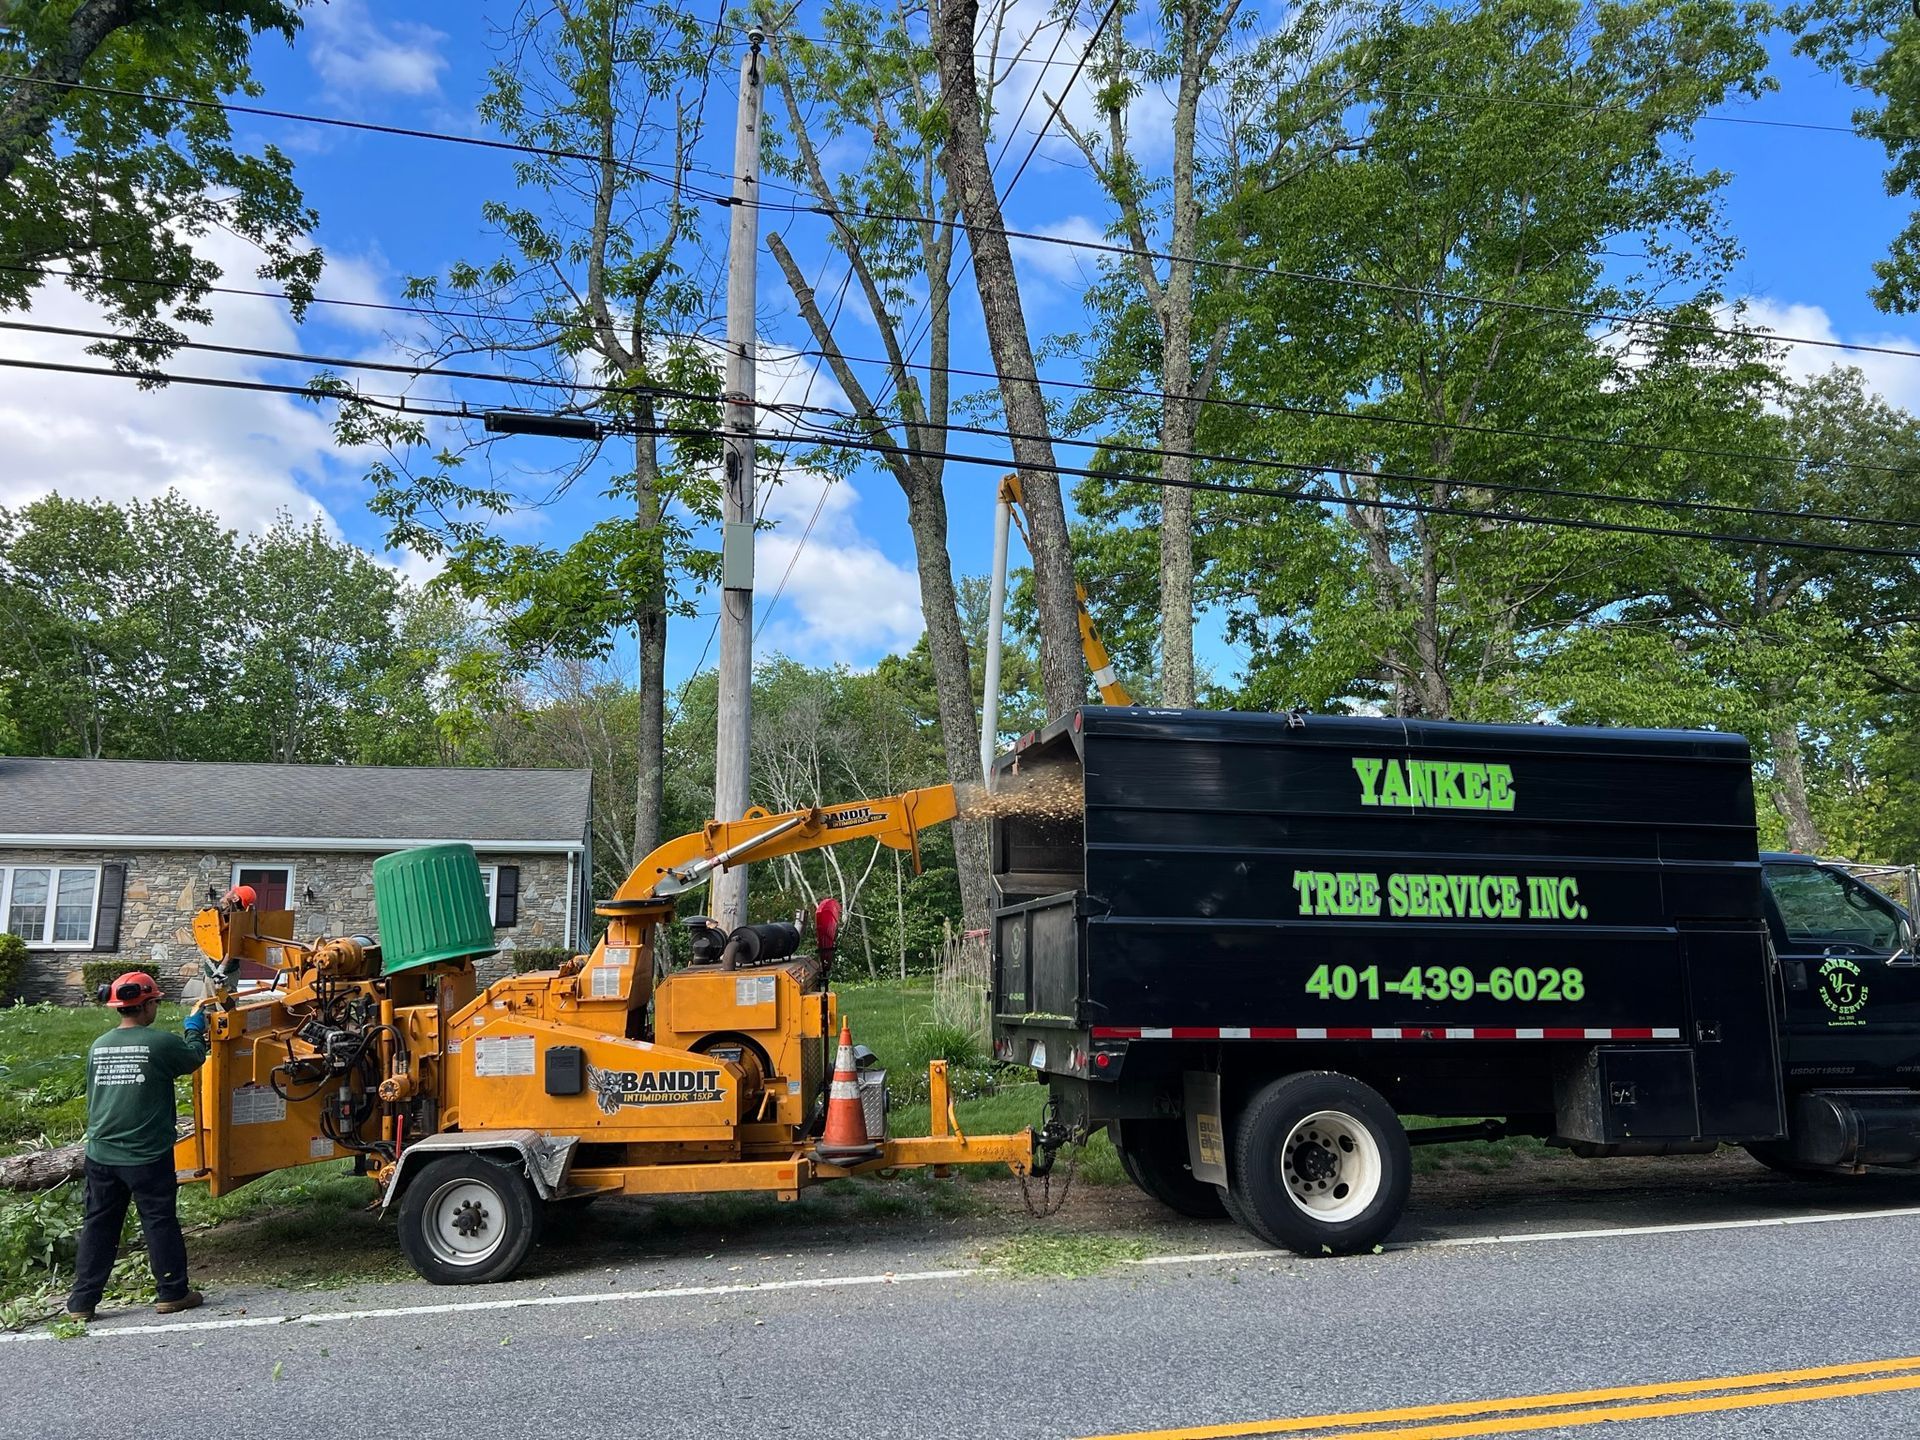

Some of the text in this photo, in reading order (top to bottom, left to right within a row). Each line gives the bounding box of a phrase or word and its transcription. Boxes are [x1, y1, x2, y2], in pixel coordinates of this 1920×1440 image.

[1352, 757, 1516, 811] YANKEE
[1293, 870, 1588, 920] TREE SERVICE INC.
[1819, 958, 1861, 976] YANKEE
[1305, 965, 1585, 1001] 401-439-6028
[1819, 986, 1868, 1014] TREE SERVICE
[621, 1071, 720, 1091] BANDIT
[623, 1091, 713, 1102] INTIMIDATOR 15XP
